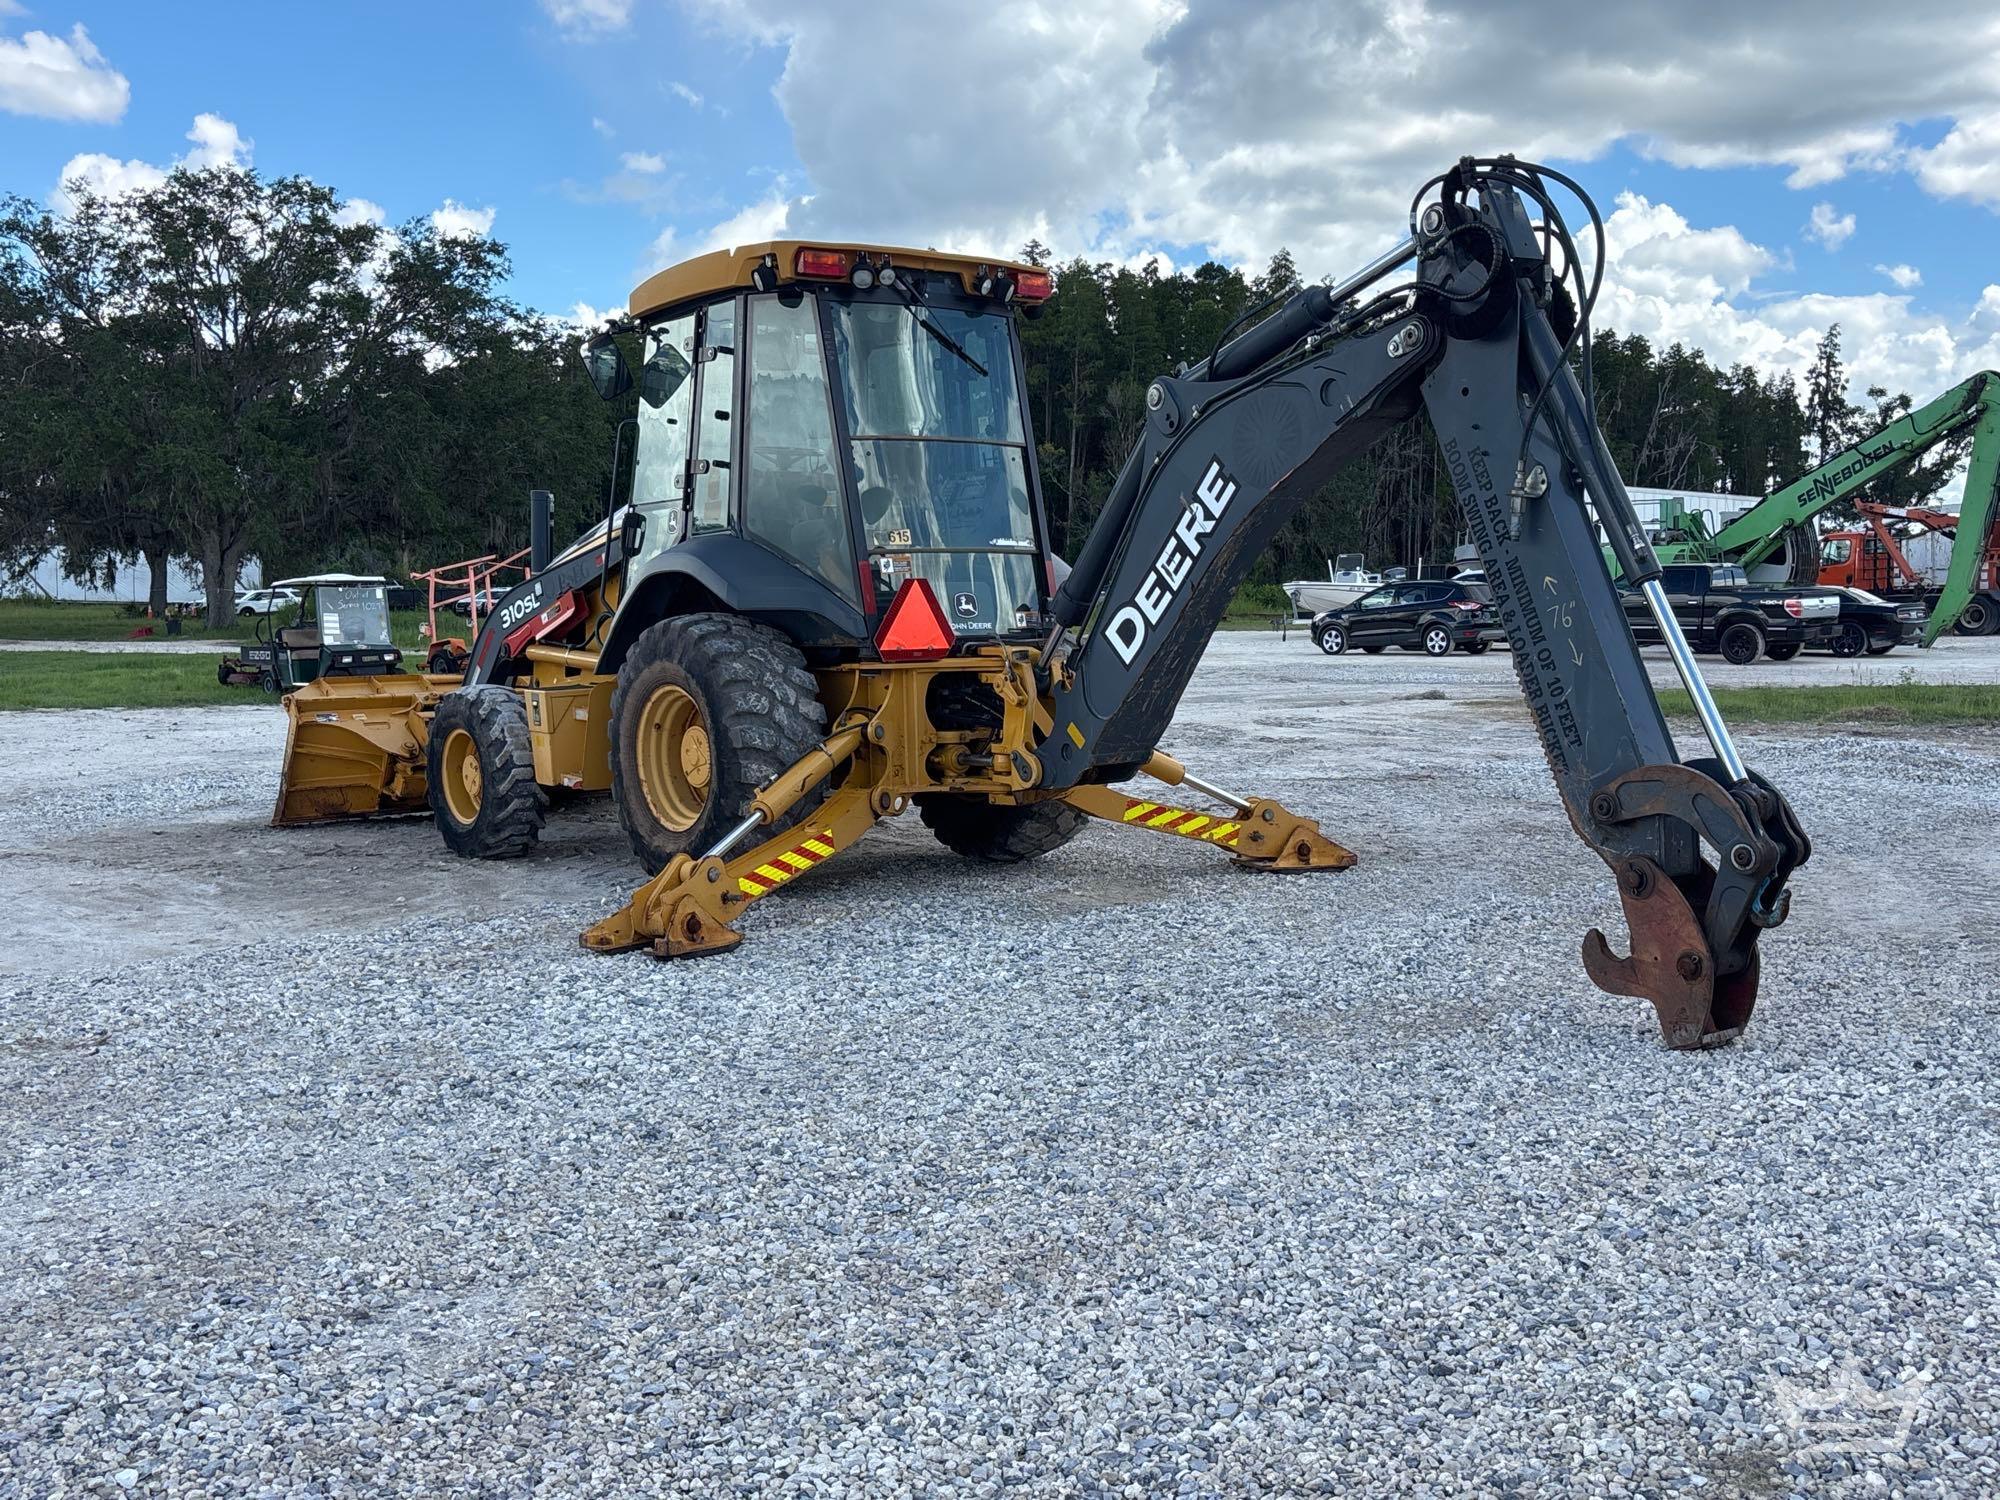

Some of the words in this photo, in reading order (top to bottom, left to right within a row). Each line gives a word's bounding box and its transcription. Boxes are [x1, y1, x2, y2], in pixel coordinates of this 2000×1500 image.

[1444, 437, 1472, 494] BOOM
[1467, 445, 1493, 492] KEEP
[1797, 440, 1895, 508] SENNEBOGEN
[888, 531, 910, 543] 615
[1463, 494, 1493, 554] SWING
[1484, 494, 1512, 546] BACK
[1104, 460, 1237, 665] DEERE
[1484, 558, 1510, 608] AREA
[500, 593, 541, 629] 310SL
[1502, 609, 1515, 622] &
[1505, 555, 1548, 646] MINIMUM
[968, 622, 993, 630] DEERE
[1507, 625, 1544, 703] LOADER
[1537, 647, 1556, 672] OF
[1546, 676, 1565, 698] 10
[1554, 698, 1583, 748] FEET
